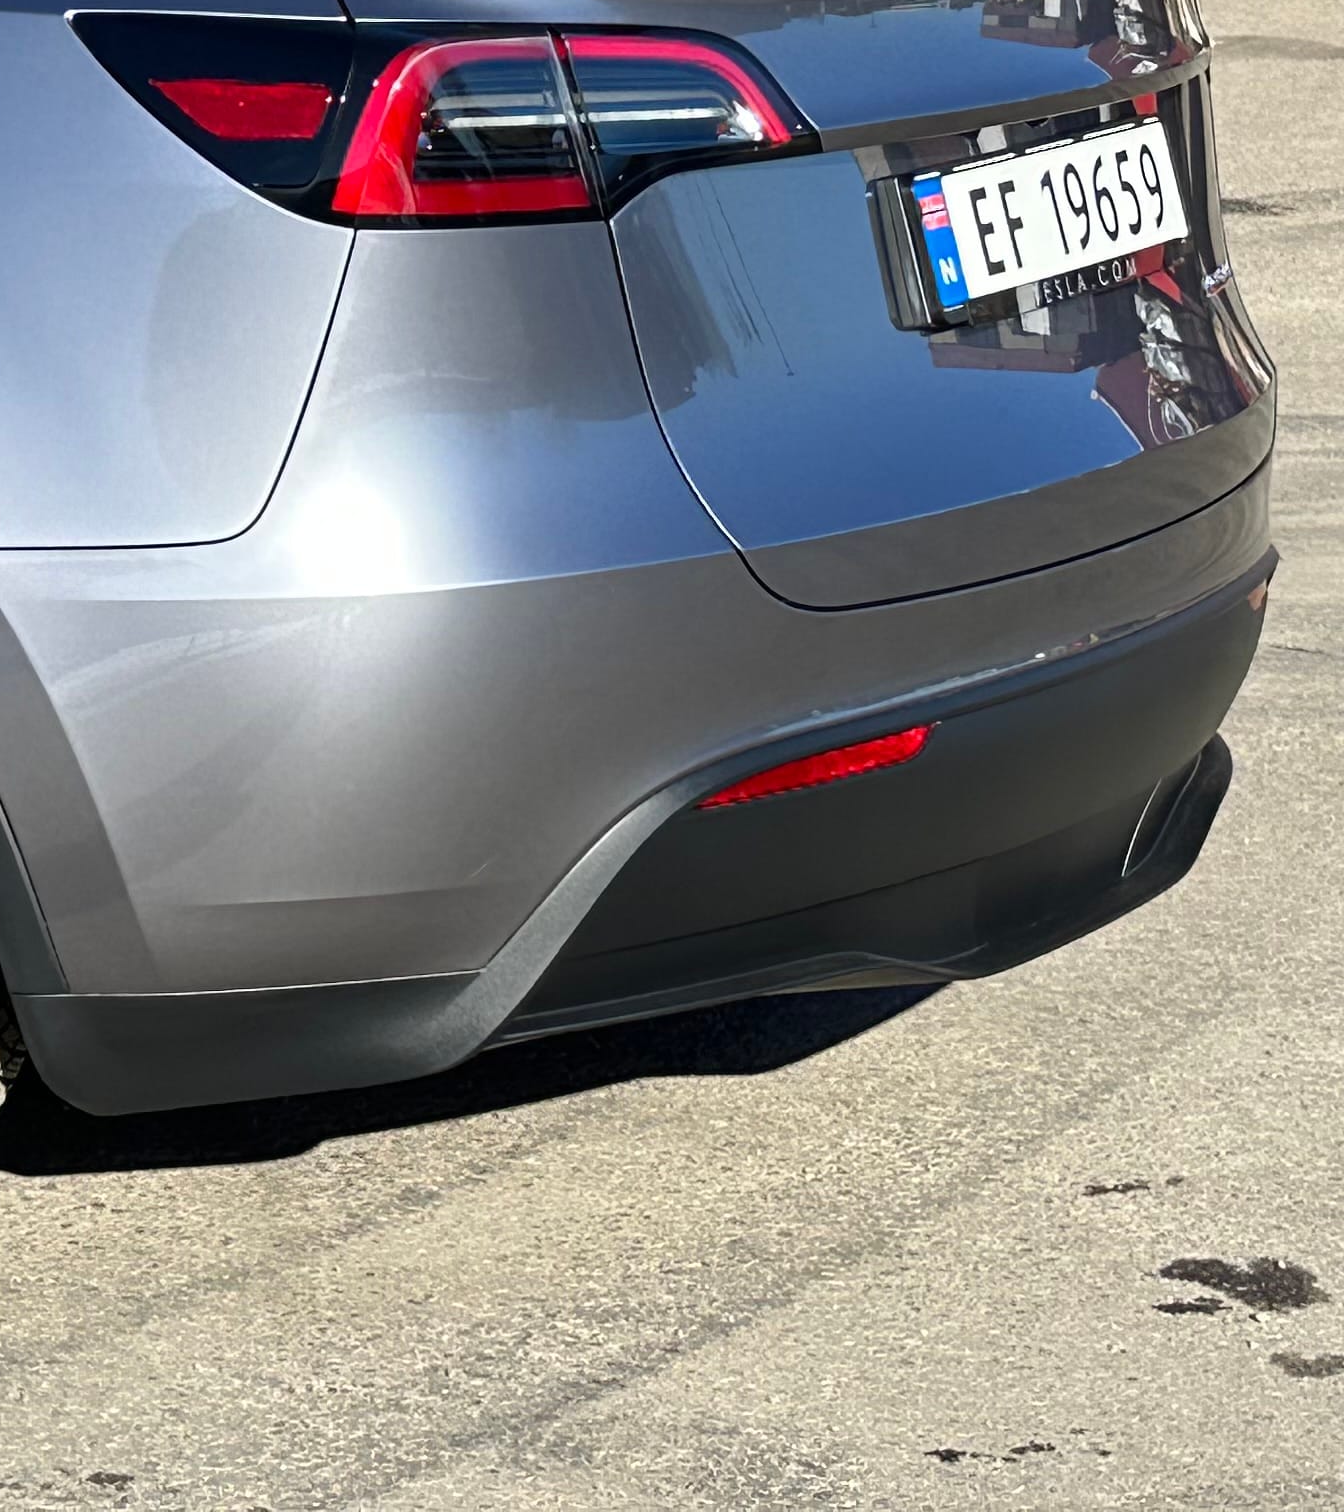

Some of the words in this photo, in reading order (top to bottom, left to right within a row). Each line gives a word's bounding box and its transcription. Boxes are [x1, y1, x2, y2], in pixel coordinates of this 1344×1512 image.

[968, 180, 1024, 277] EF
[1040, 144, 1166, 256] 19659
[938, 256, 958, 286] N
